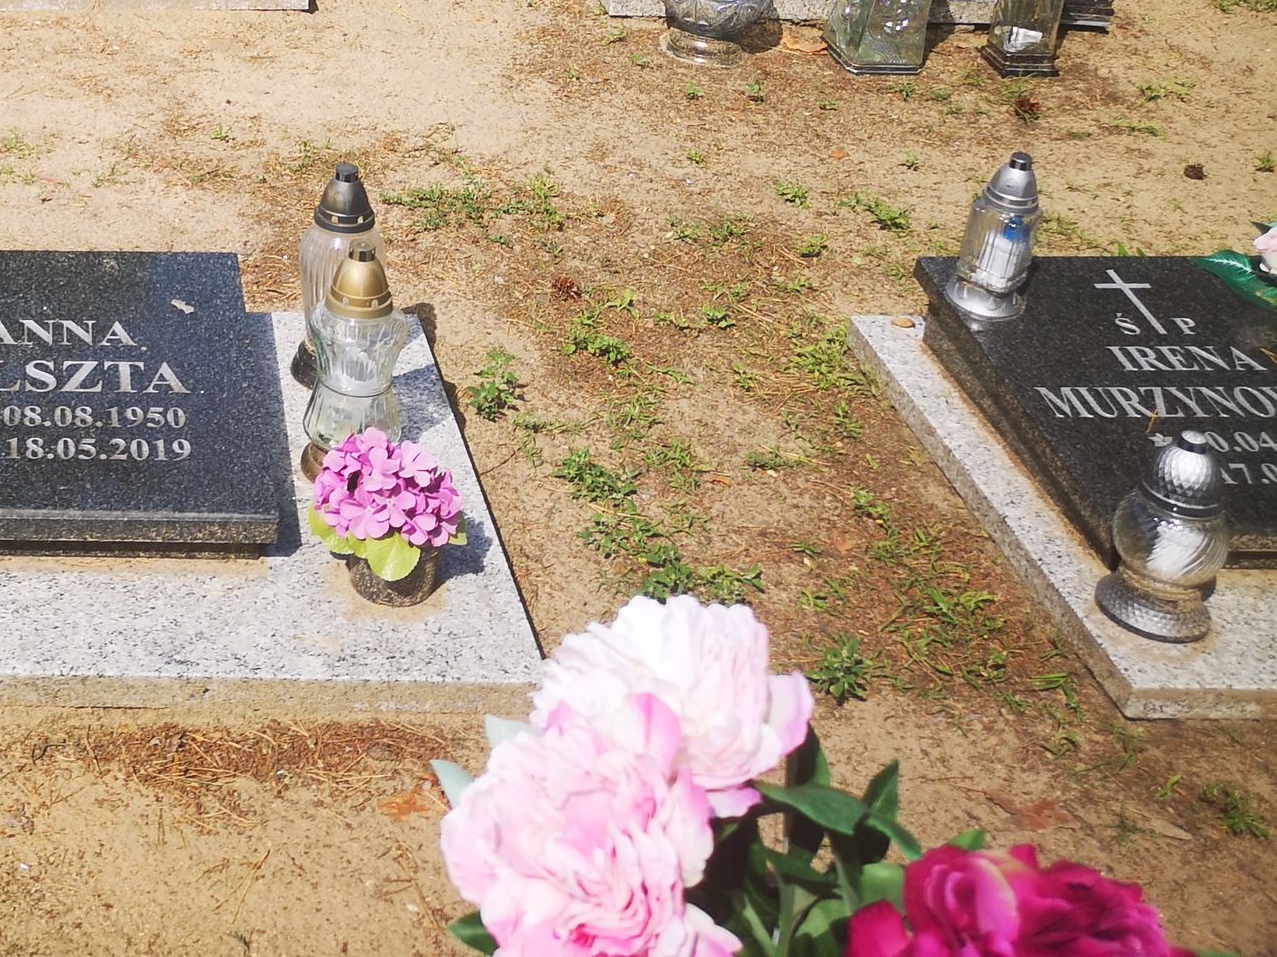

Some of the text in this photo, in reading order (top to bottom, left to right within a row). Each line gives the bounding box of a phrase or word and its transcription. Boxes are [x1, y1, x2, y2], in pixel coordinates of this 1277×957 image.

[1105, 345, 1268, 372] IRENA
[1032, 385, 1277, 419] MURZYNO
[2, 404, 187, 429] 08.08.1950
[3, 436, 193, 461] 18.05.2019
